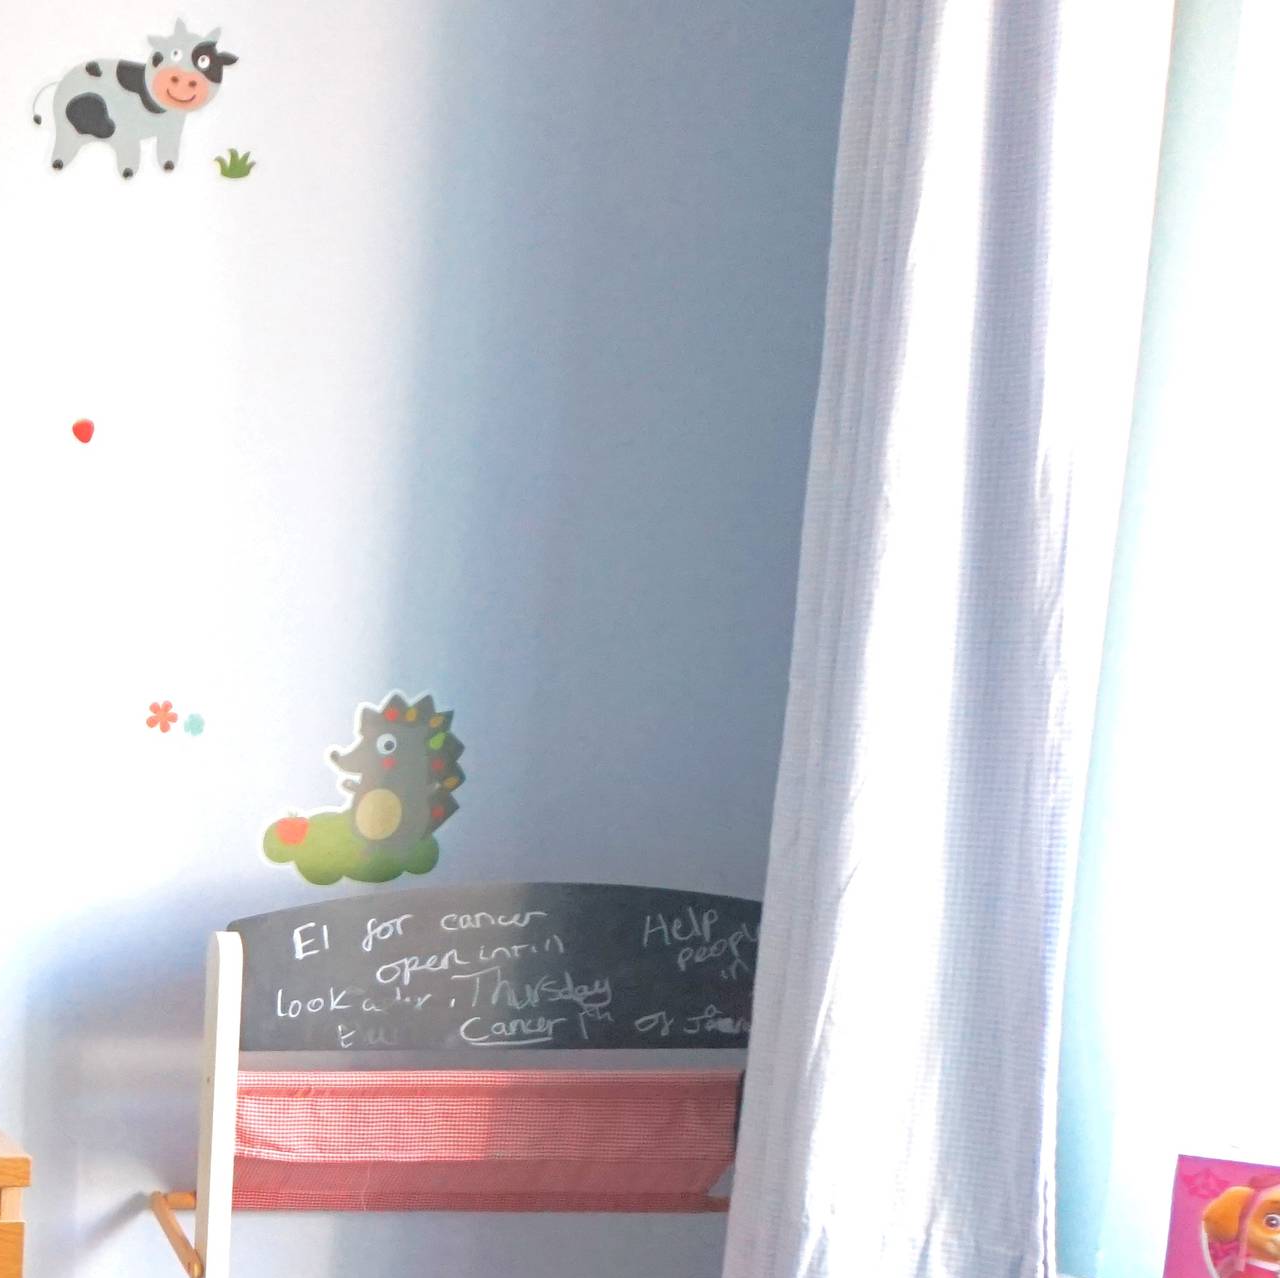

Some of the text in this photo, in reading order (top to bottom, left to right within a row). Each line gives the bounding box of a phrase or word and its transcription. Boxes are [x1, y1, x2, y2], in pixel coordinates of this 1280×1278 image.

[362, 913, 414, 951] for
[440, 910, 548, 931] cancer
[375, 948, 471, 986] open
[459, 1015, 568, 1043] Cancer
